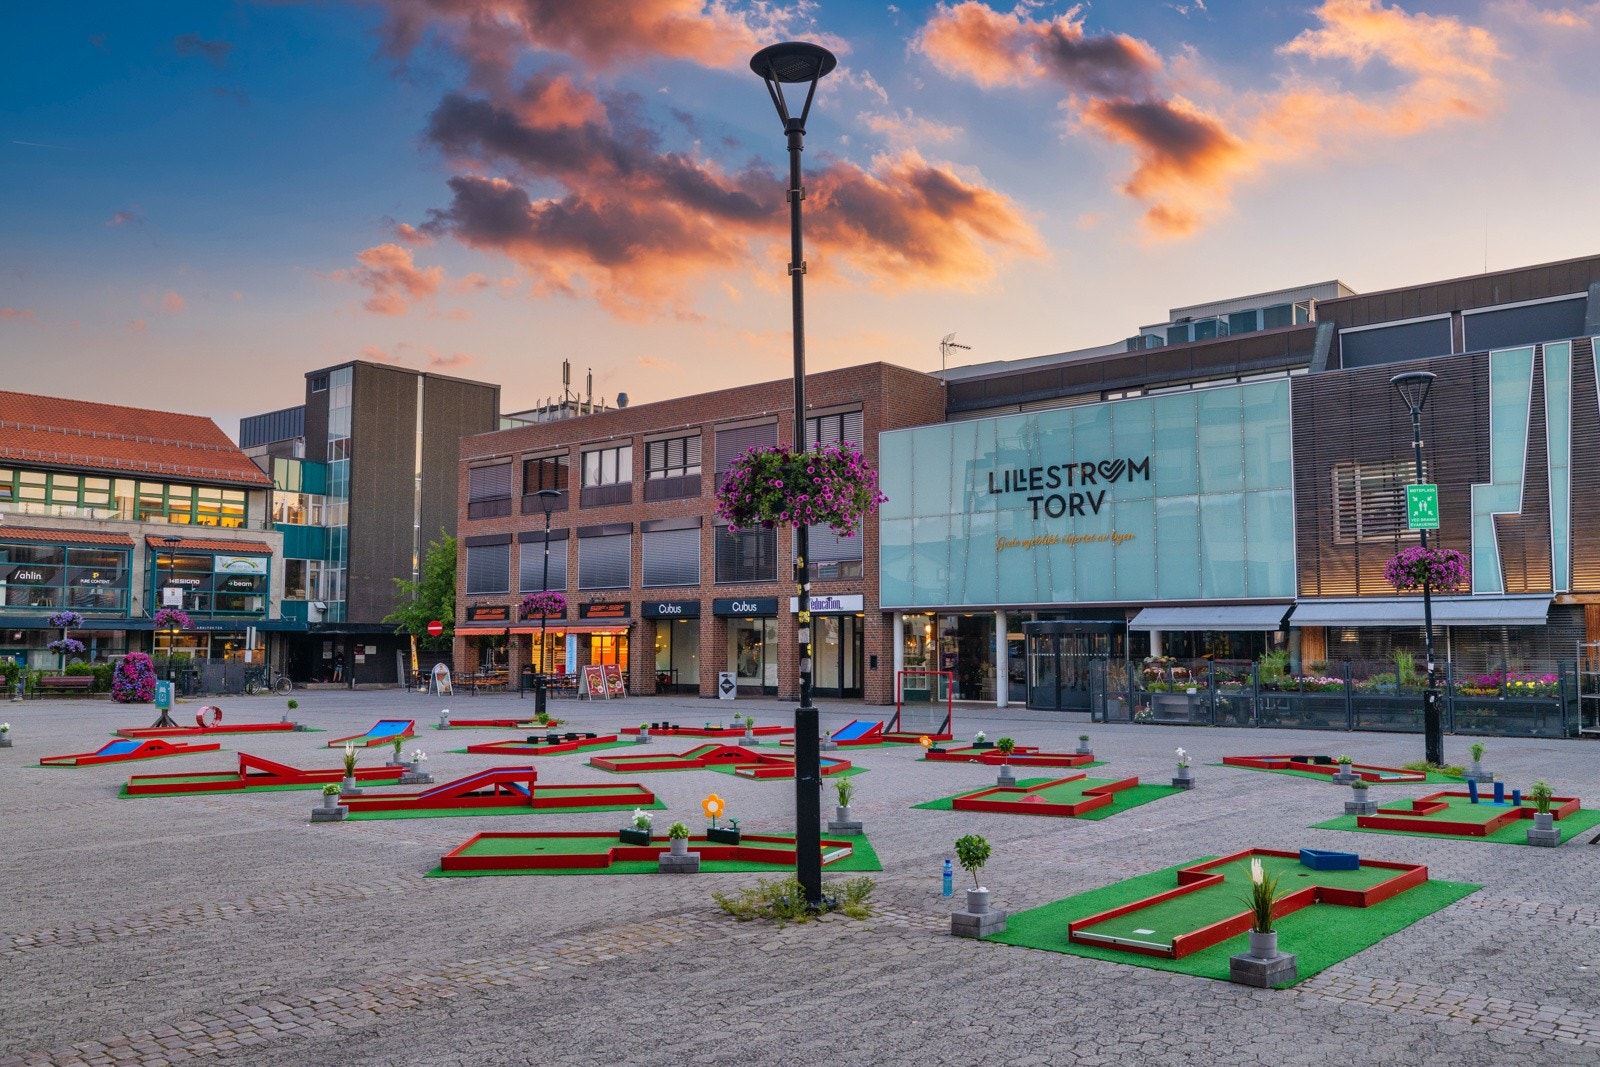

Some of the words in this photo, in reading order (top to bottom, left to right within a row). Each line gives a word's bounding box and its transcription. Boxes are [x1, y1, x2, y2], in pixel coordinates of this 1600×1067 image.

[1027, 489, 1106, 520] TORV
[658, 604, 682, 614] Cubus
[731, 601, 757, 612] Cubus
